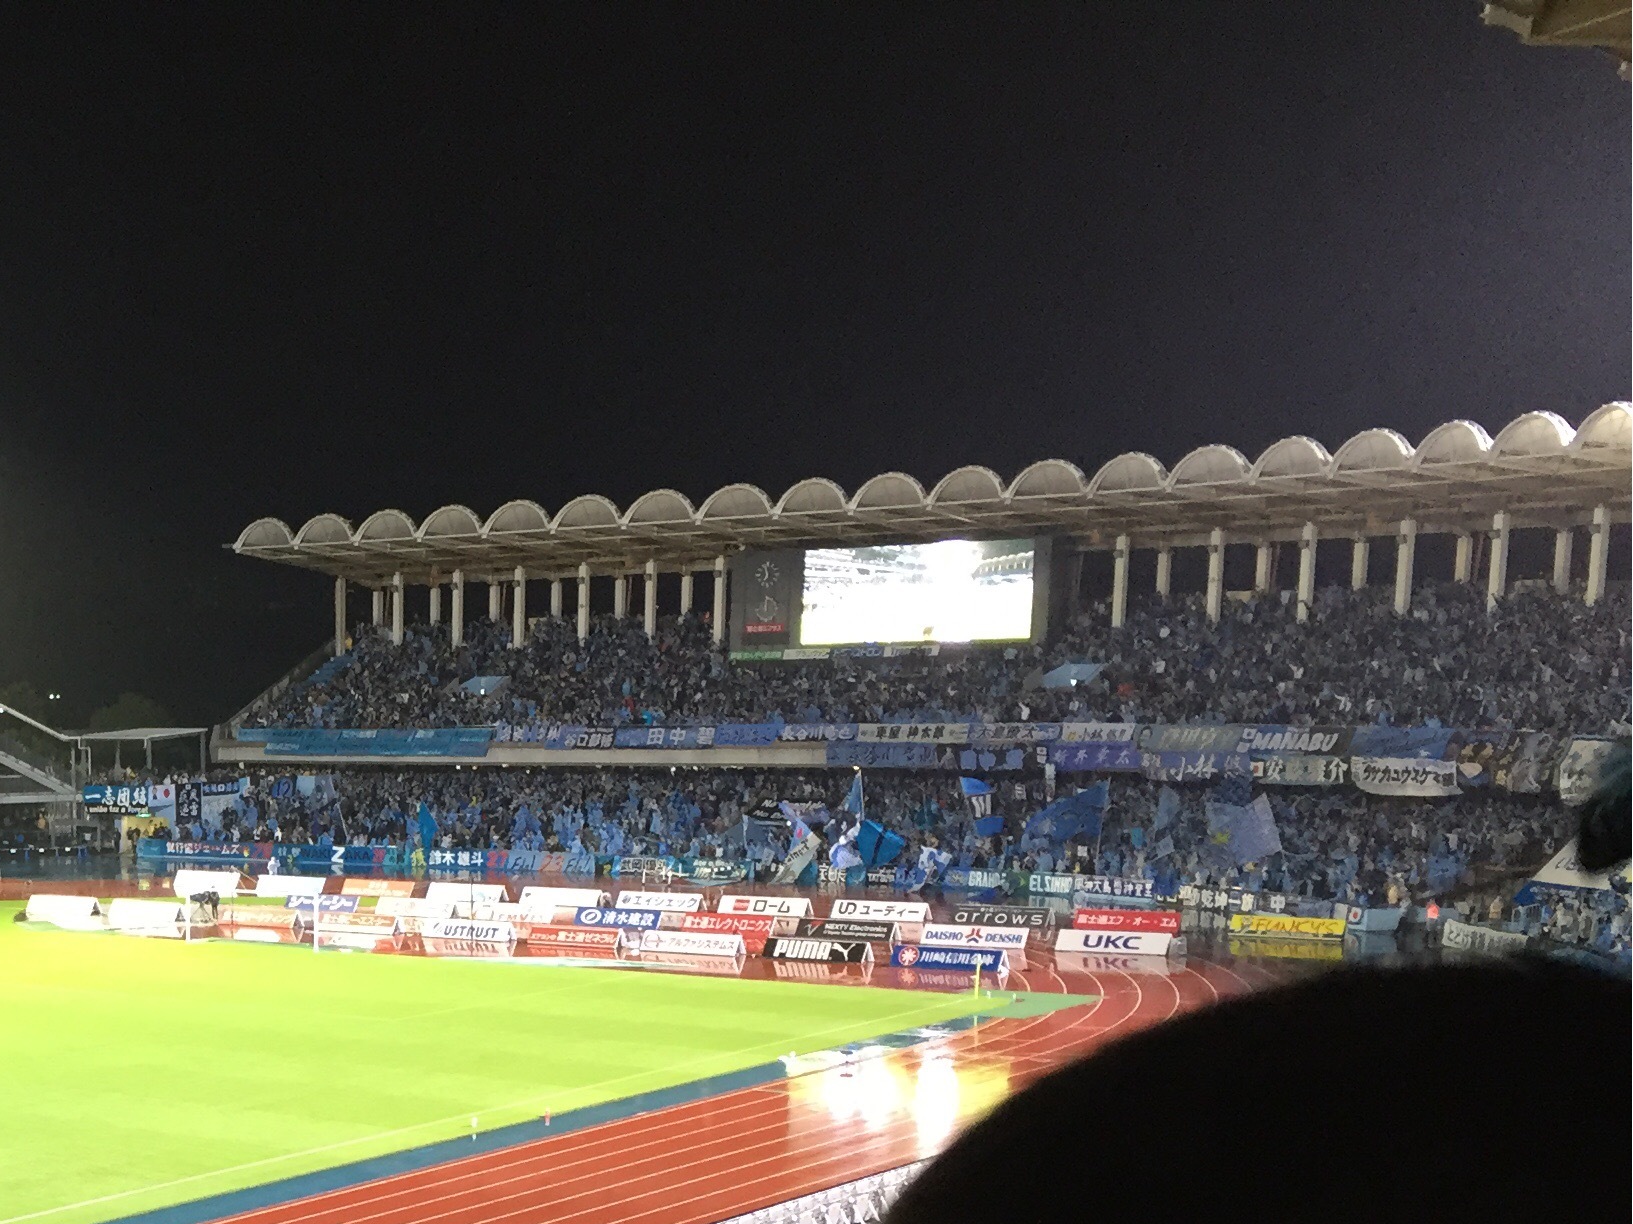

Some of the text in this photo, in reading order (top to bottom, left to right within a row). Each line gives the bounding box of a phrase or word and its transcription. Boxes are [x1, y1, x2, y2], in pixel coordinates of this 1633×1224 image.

[1251, 732, 1339, 752] MANABU
[1267, 755, 1348, 784] 安介
[753, 900, 790, 913] ローム
[860, 904, 920, 917] ユーディー
[954, 911, 1044, 926] arrows
[984, 933, 1023, 944] DENSHI
[1082, 934, 1142, 950] UKC
[773, 939, 833, 961] PUMA
